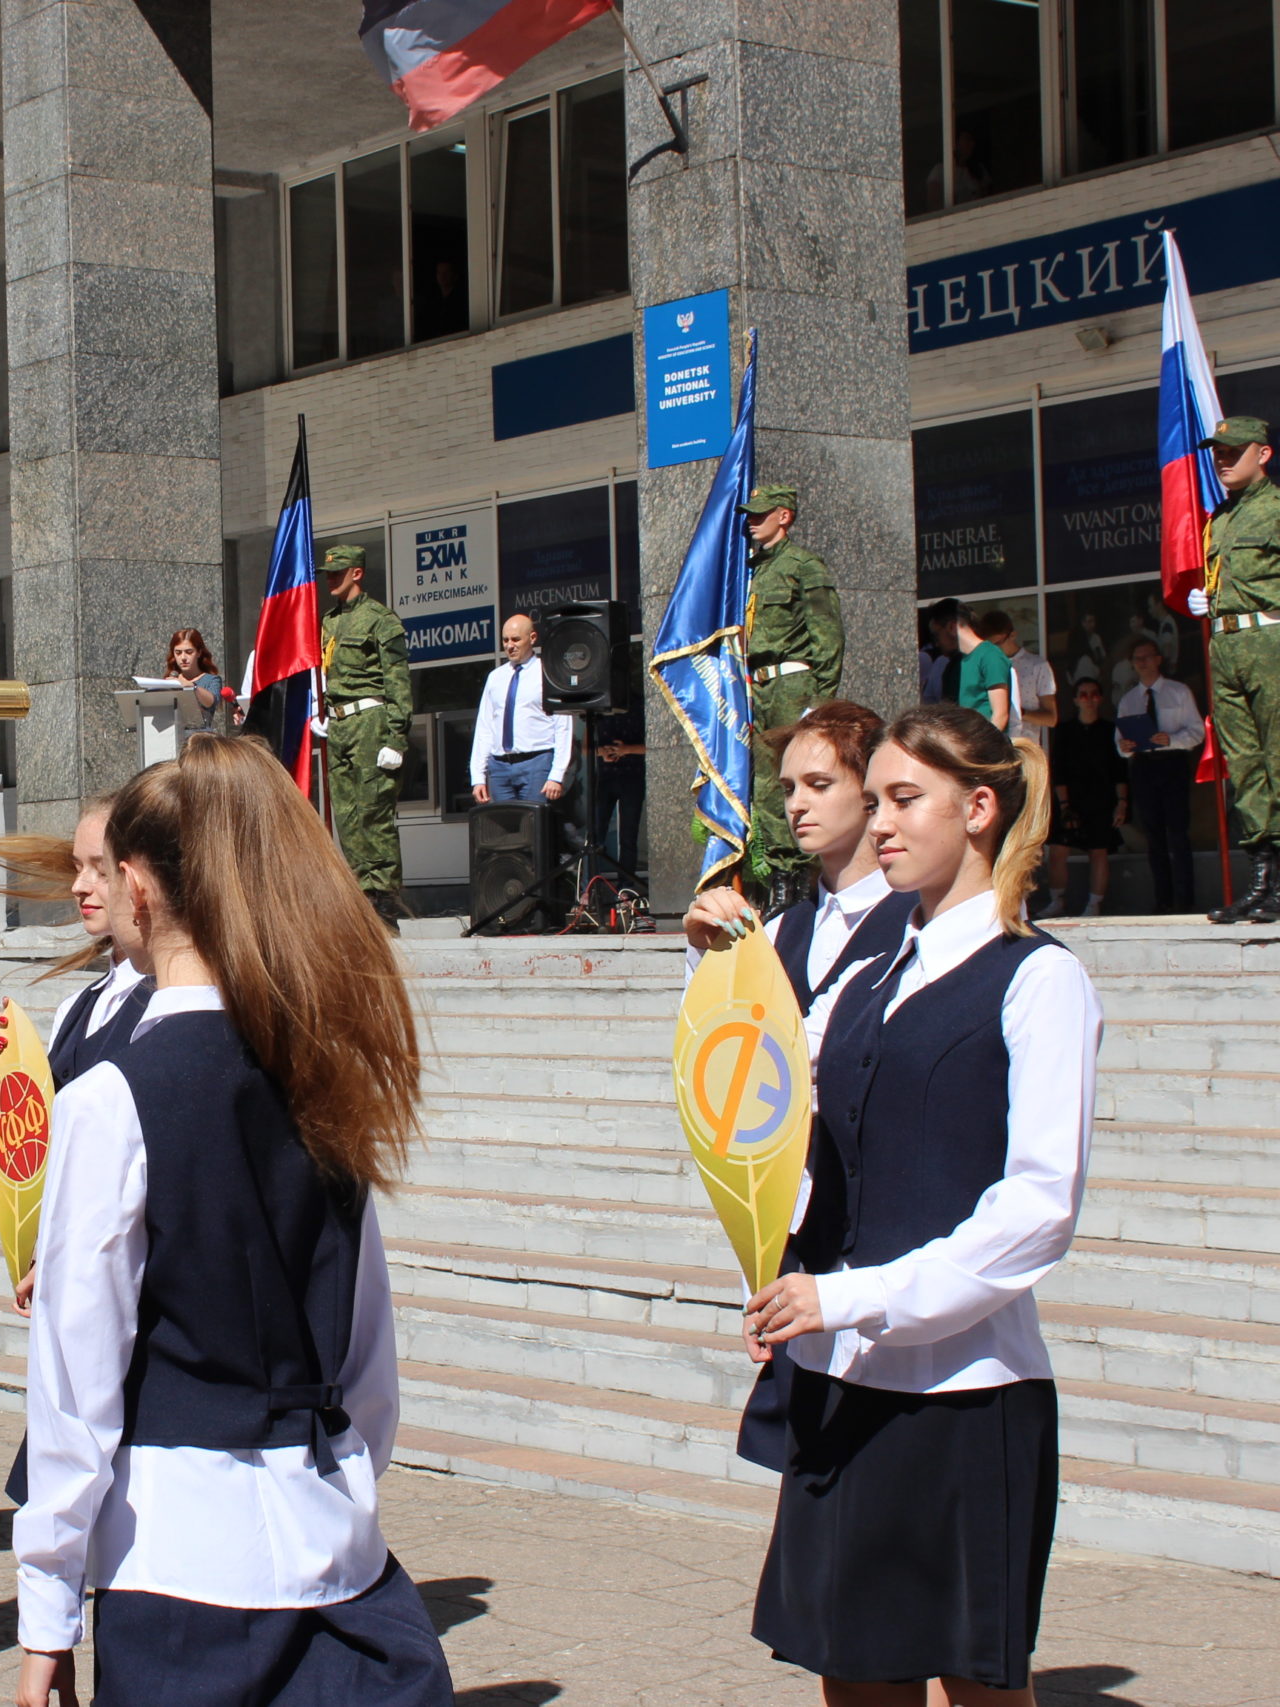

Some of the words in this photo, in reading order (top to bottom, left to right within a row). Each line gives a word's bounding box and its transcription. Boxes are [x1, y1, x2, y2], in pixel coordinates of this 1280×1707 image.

[664, 365, 709, 383] DONETSK
[664, 379, 710, 396] NATIONAL
[659, 390, 716, 410] UNIVERSITY
[1064, 505, 1129, 531] VIVANT
[425, 528, 459, 542] UKR
[416, 540, 467, 572] EXIM
[416, 568, 468, 586] BANK
[515, 582, 600, 608] MAECENATUM
